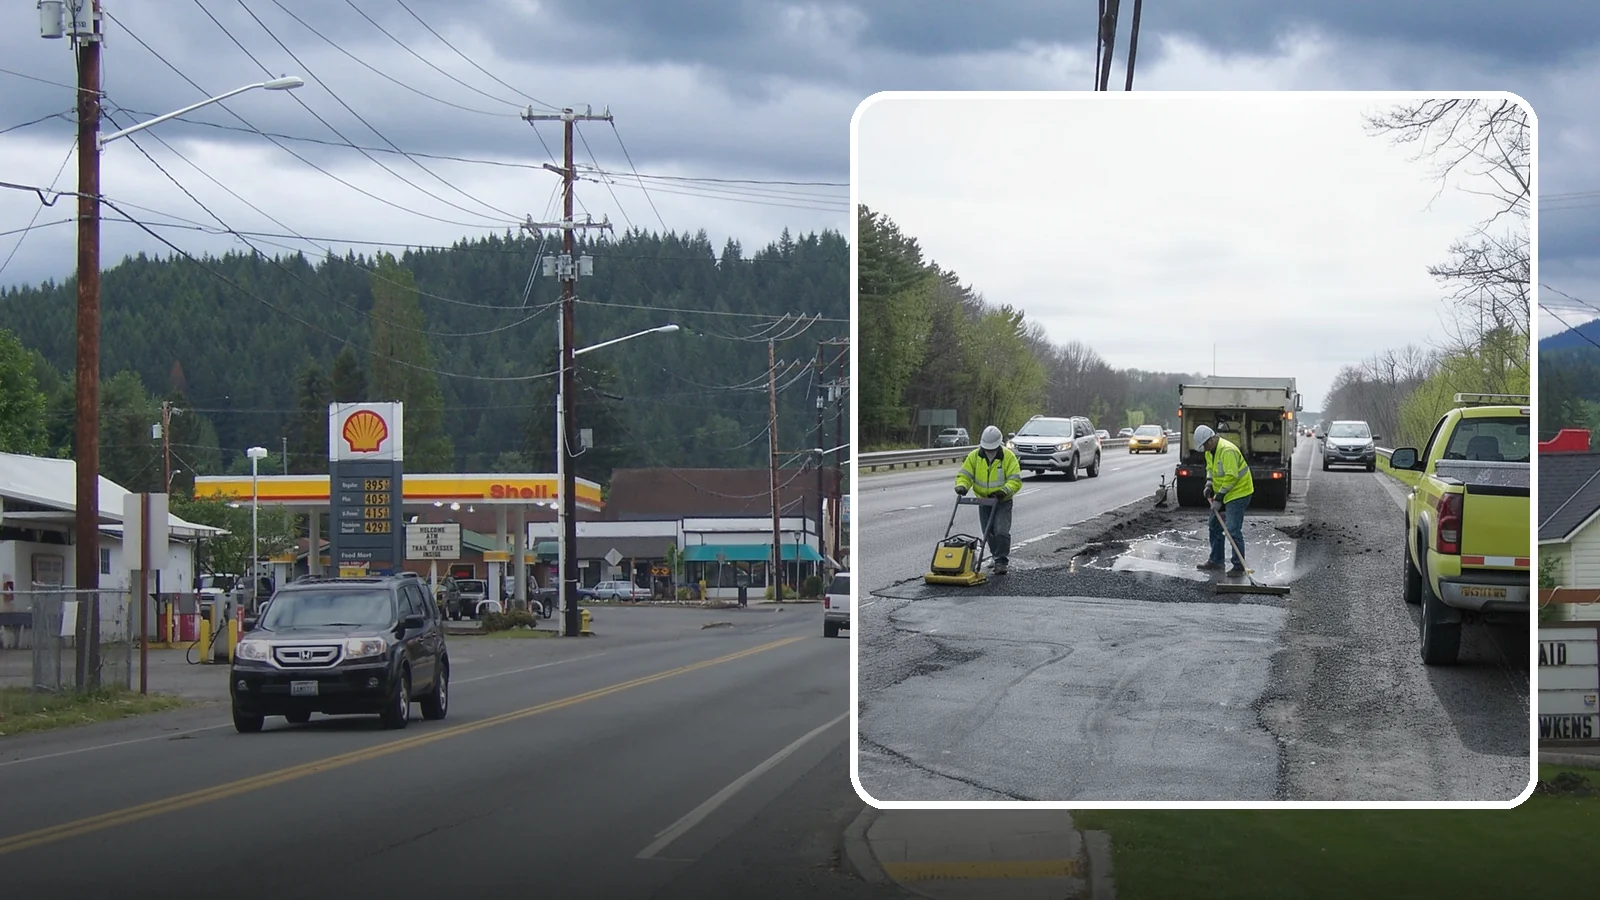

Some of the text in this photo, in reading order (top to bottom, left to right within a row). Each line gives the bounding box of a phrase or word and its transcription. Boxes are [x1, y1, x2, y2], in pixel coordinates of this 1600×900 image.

[366, 480, 383, 490] 395
[490, 484, 546, 499] Shell
[366, 494, 383, 504] 405
[366, 508, 383, 517] 415
[366, 522, 383, 532] 429
[1539, 643, 1567, 665] AID
